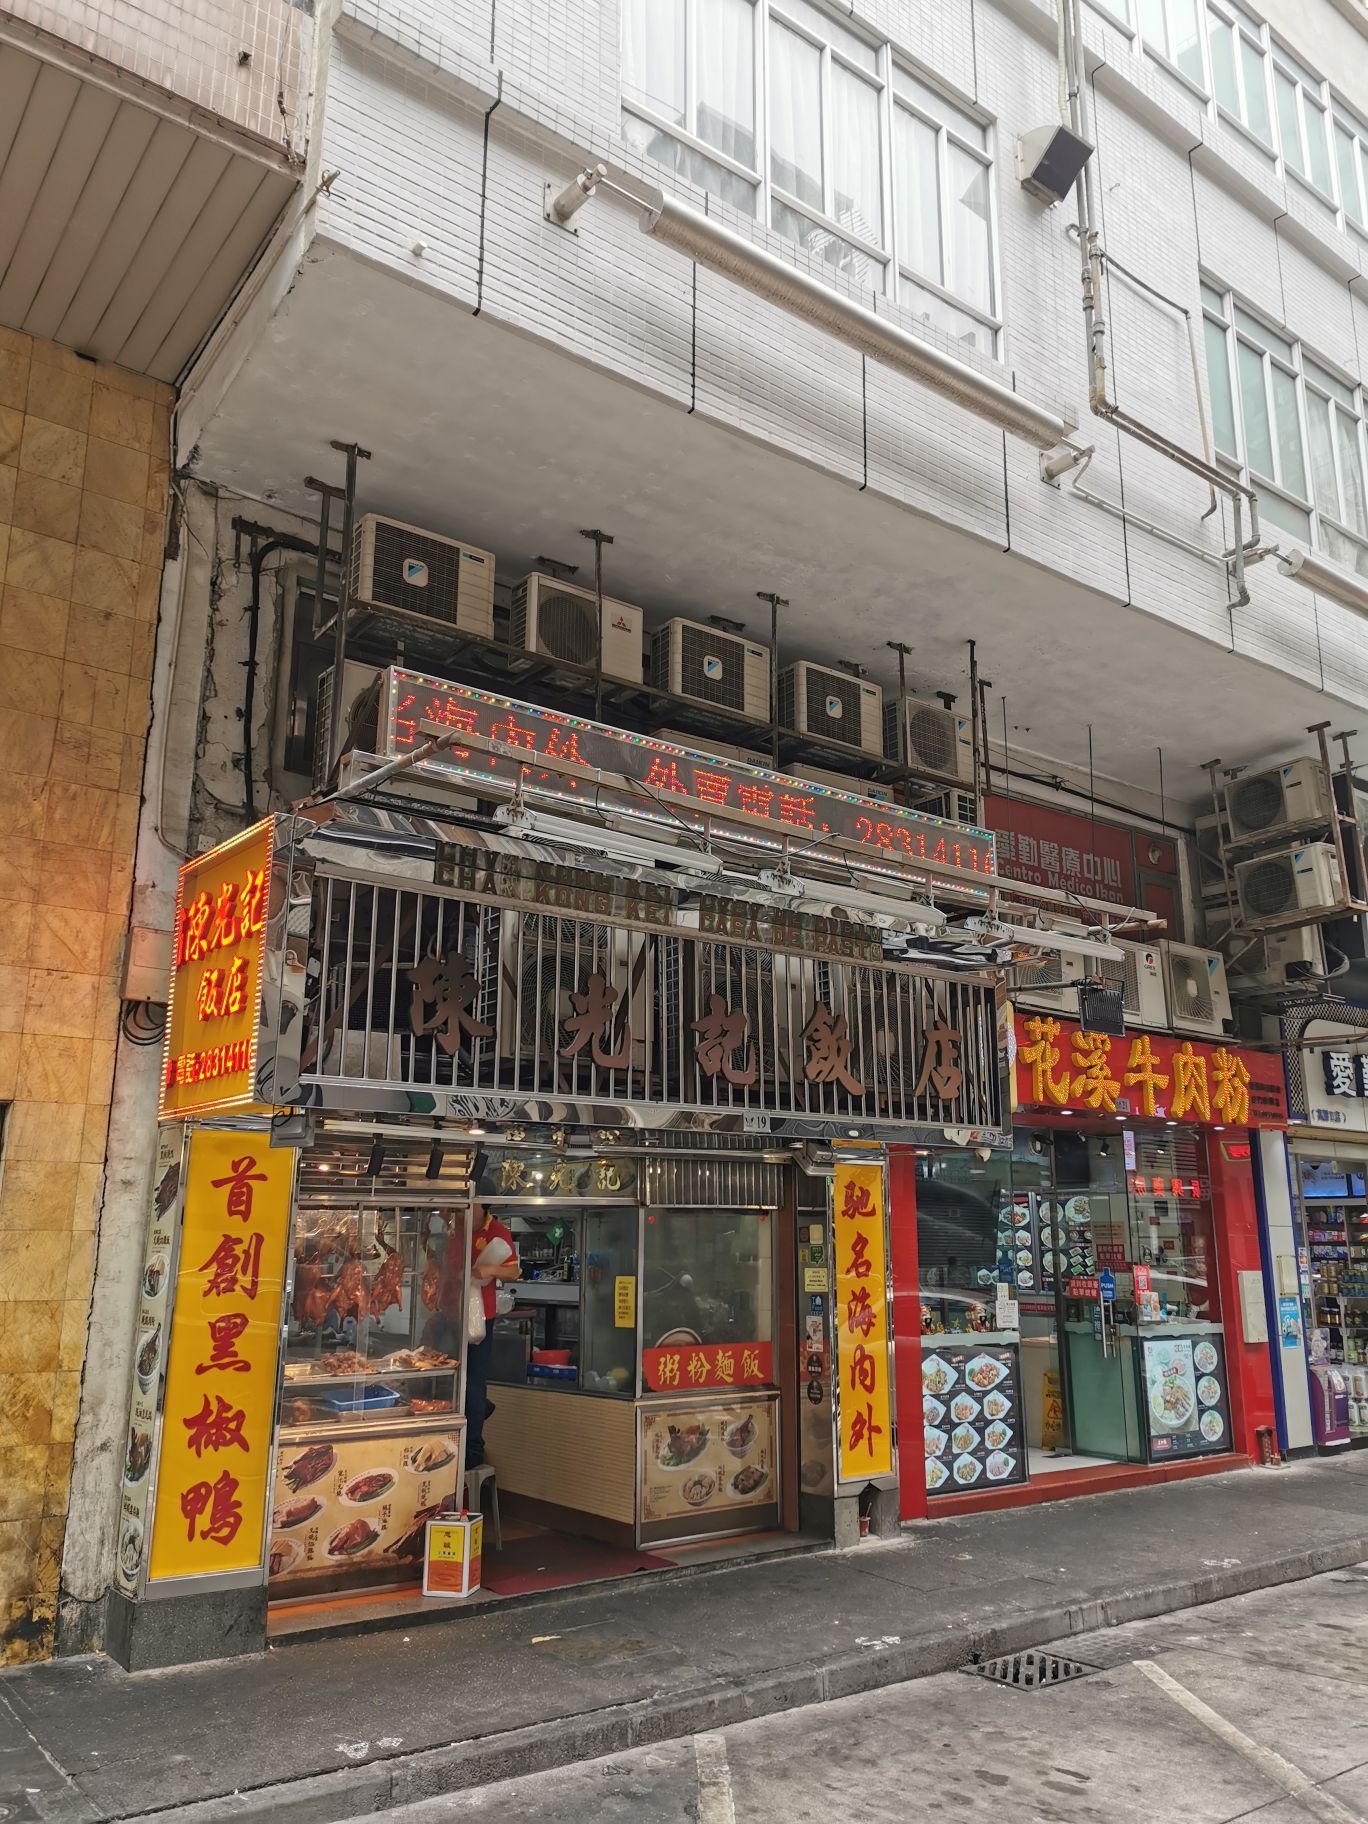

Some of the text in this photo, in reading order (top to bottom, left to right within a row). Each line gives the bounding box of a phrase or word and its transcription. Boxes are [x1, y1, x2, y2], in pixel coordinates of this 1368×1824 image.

[183, 869, 266, 961] 陳光記
[535, 881, 611, 916] KONG
[626, 896, 672, 925] KEI
[1048, 871, 1094, 896] Médico
[700, 911, 759, 942] CASA
[772, 923, 801, 949] DE
[196, 955, 245, 1021] 飯店
[406, 951, 963, 1099] 陳光記飯店
[1019, 1015, 1251, 1126] 花溪牛肉粉
[757, 1115, 767, 1129] 19
[179, 1156, 268, 1546] 首創黑椒鴨
[841, 1181, 883, 1458] 馳名海內外
[658, 1349, 765, 1386] 粥粉麵飯
